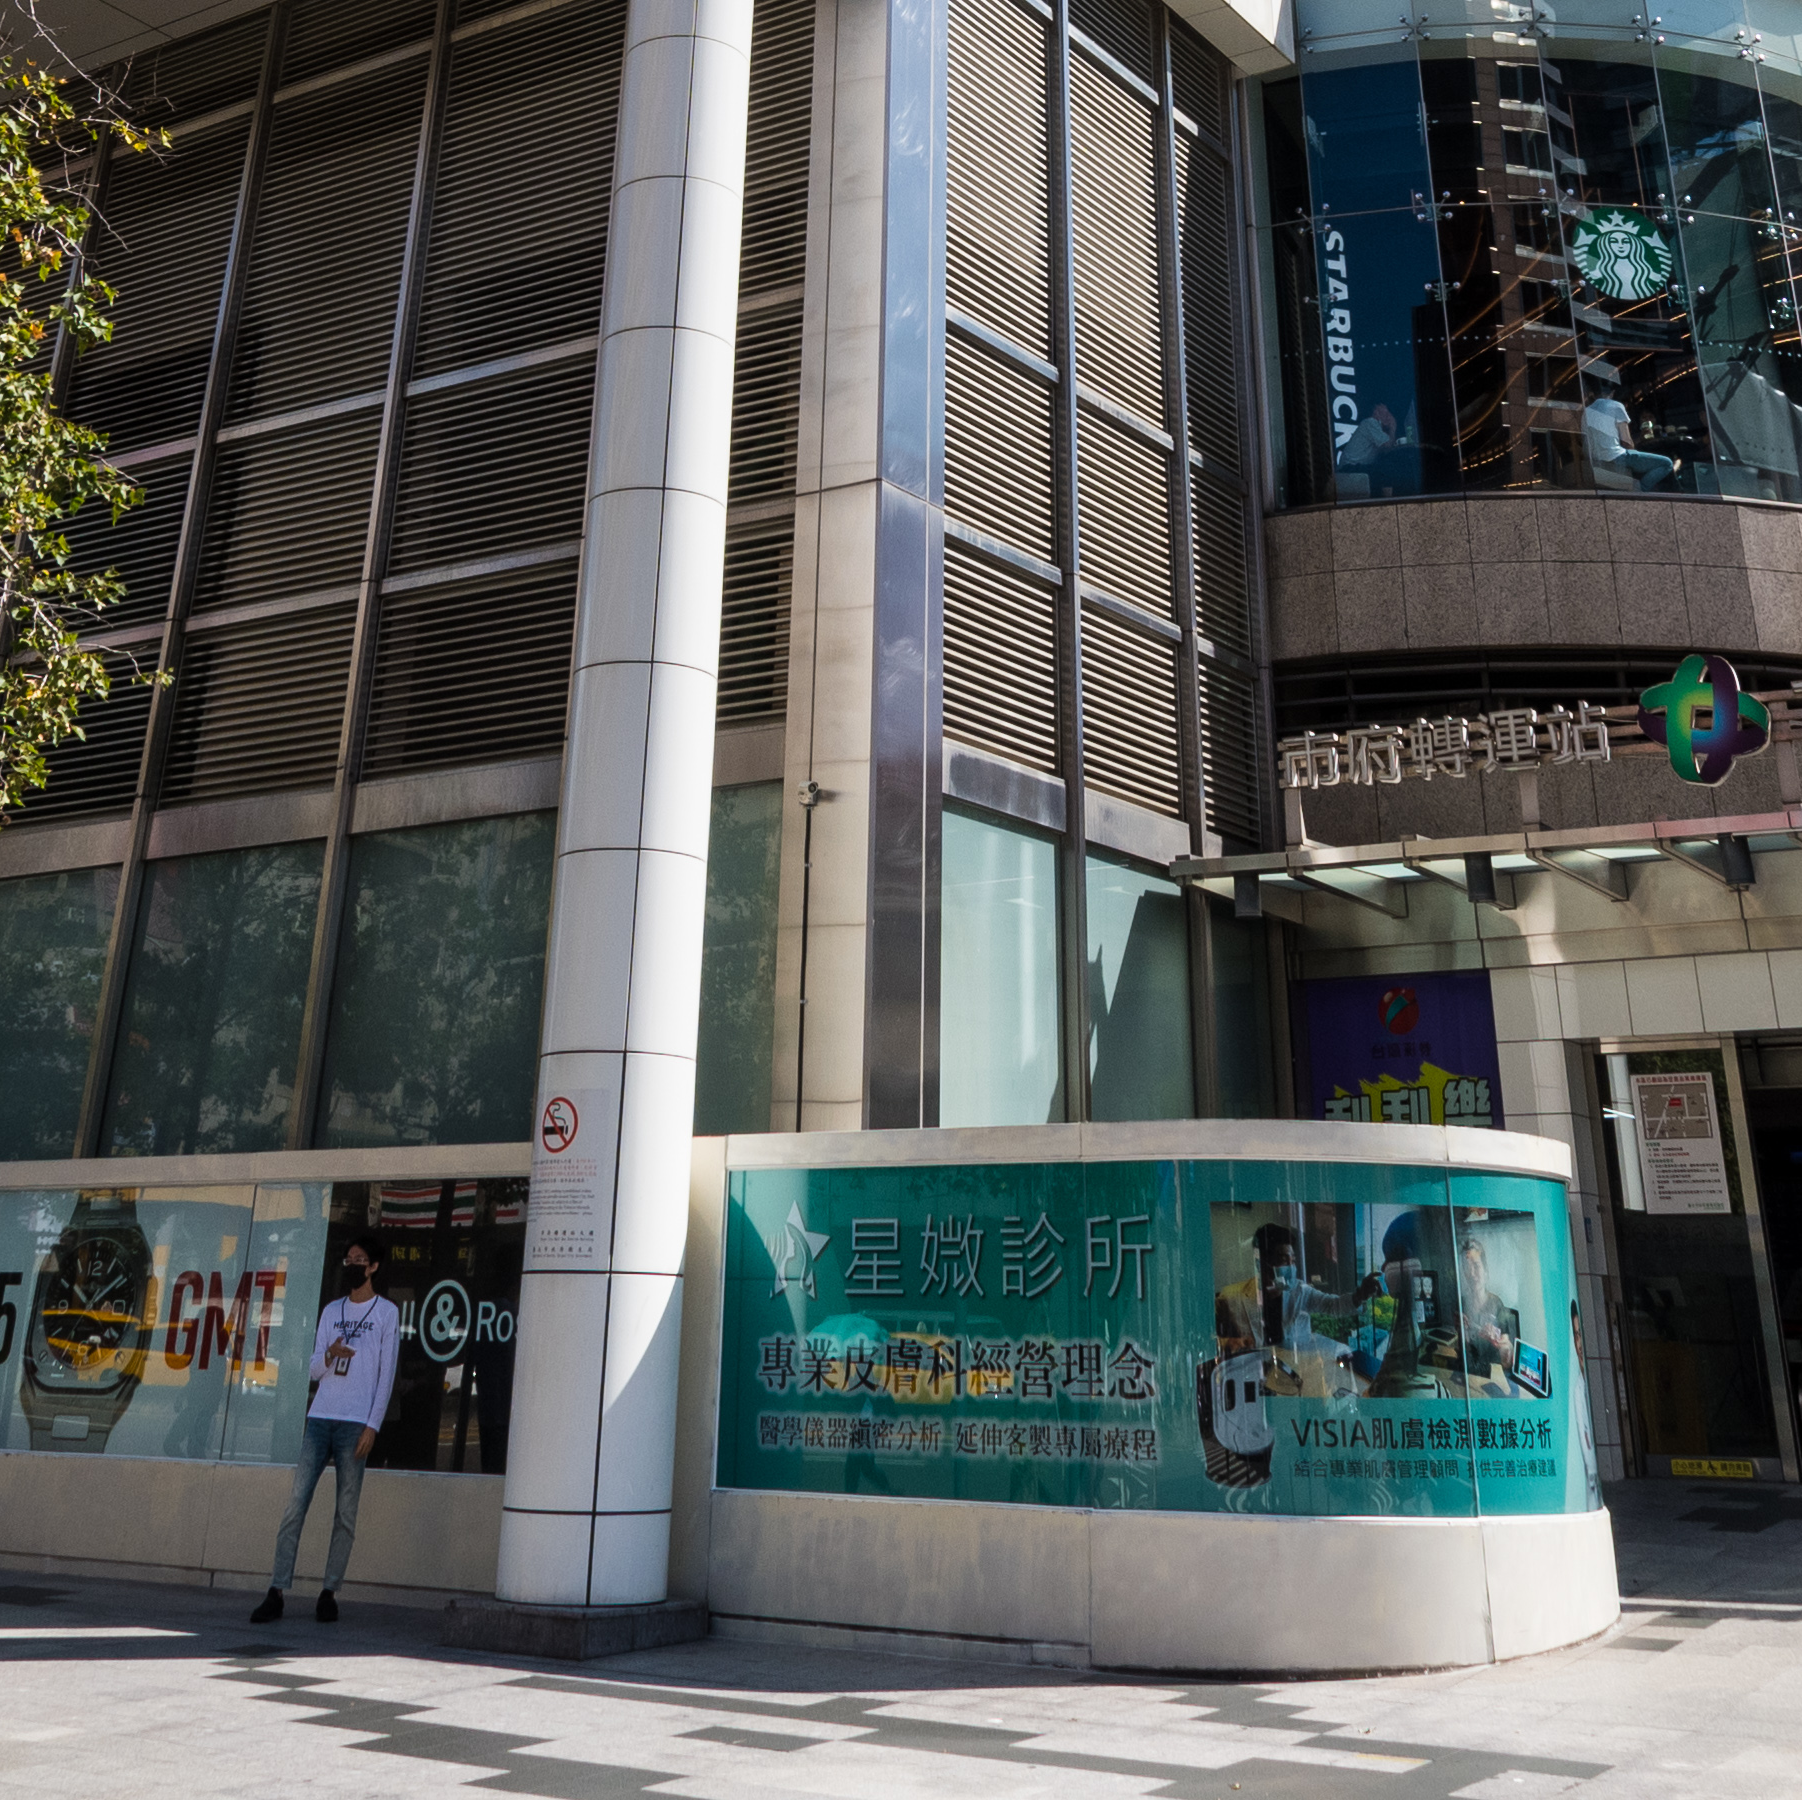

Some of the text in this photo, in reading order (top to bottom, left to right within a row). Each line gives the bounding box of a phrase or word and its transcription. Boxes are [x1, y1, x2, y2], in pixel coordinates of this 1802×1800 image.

[1282, 700, 1611, 790] 市府轉運站
[164, 1270, 287, 1371] GMT
[476, 1301, 514, 1343] Ro
[758, 1336, 1157, 1400] 專業皮膚科經營理念
[955, 1422, 1158, 1462] 延伸客製專屬療程
